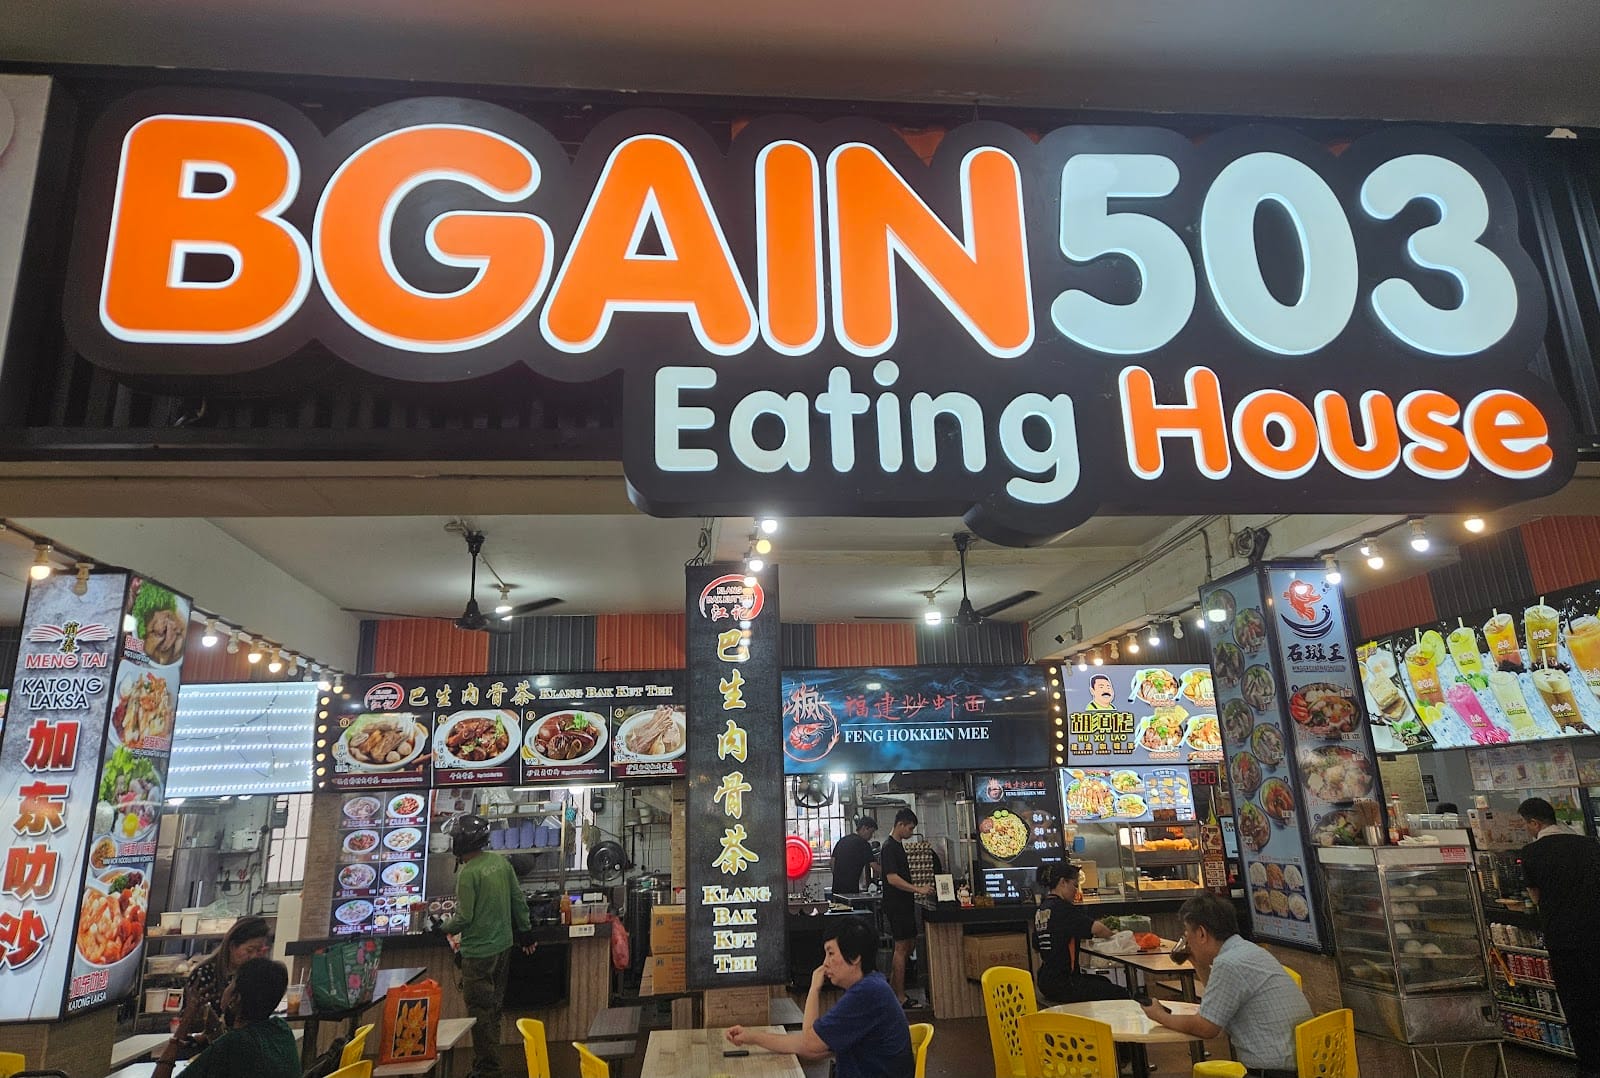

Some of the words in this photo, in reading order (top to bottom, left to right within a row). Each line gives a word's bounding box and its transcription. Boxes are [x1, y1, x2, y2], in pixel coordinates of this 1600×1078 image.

[100, 113, 1036, 359] BGAIN
[1050, 151, 1518, 356] 503
[655, 359, 1081, 504] Eating
[1118, 365, 1554, 480] House
[25, 654, 78, 669] MENG
[81, 653, 108, 668] TAI
[1287, 643, 1345, 662] 石斑王
[21, 677, 104, 695] KATONG
[409, 680, 536, 708] 巴生肉骨茶
[539, 688, 584, 700] KLANG
[585, 687, 614, 699] BAK
[616, 686, 643, 698] KUT
[645, 685, 673, 697] TEH
[28, 693, 89, 710] LAKSA
[844, 730, 883, 744] FENG
[886, 727, 955, 743] HOKKIEN
[957, 726, 989, 740] MEE
[1078, 734, 1089, 742] HU
[1094, 734, 1105, 742] XU
[1110, 734, 1127, 742] LAO
[701, 885, 772, 905] KLANG
[713, 907, 757, 926] BAK
[713, 930, 757, 950] KUT
[713, 954, 757, 973] TEH
